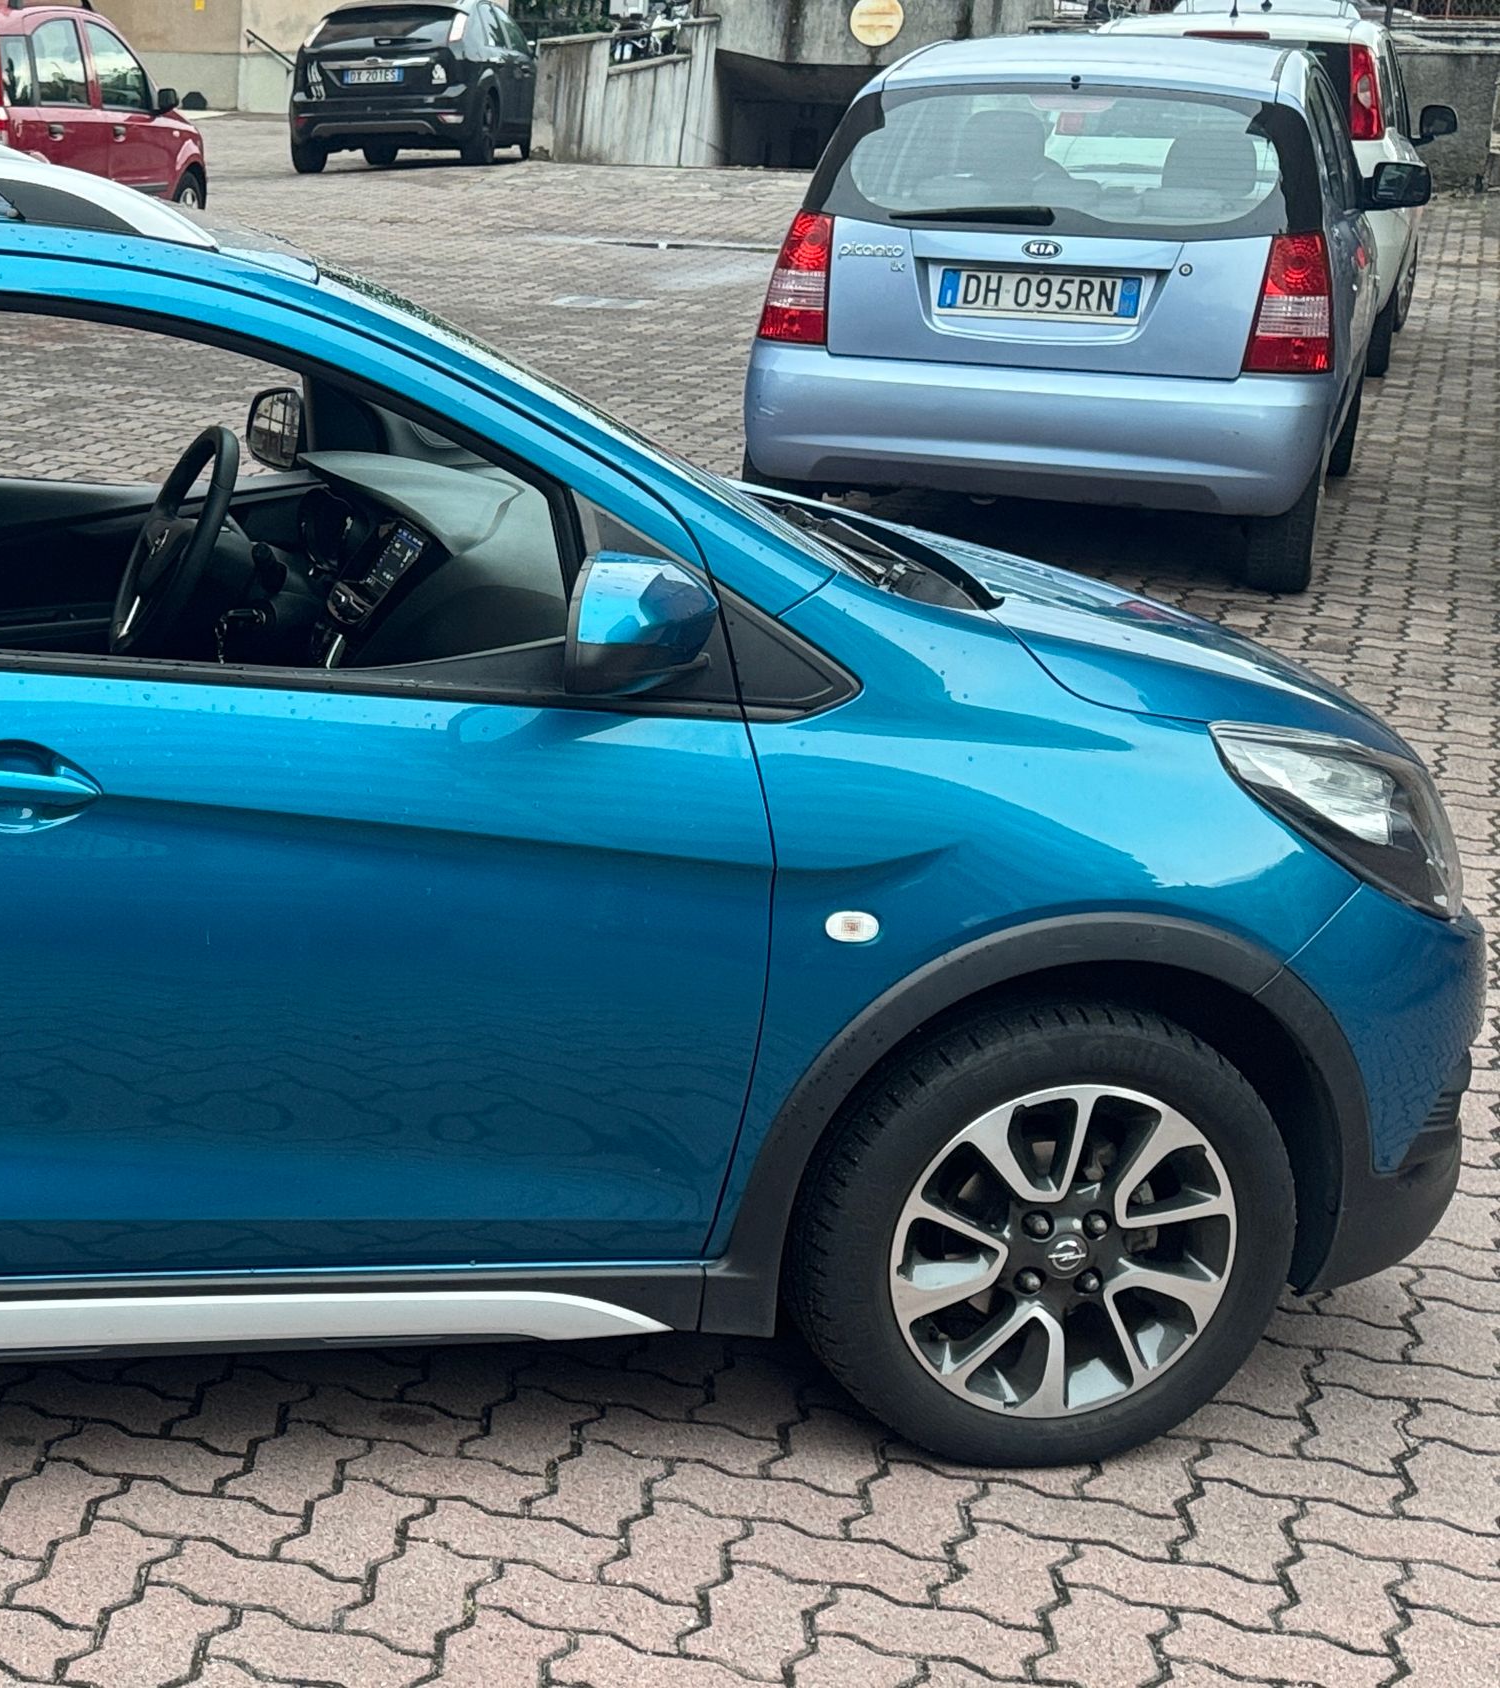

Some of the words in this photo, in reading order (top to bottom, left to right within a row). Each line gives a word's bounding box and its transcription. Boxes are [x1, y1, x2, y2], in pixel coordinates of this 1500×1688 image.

[1029, 243, 1055, 254] KIA
[962, 274, 1003, 306] DH
[1013, 276, 1118, 312] 095RN
